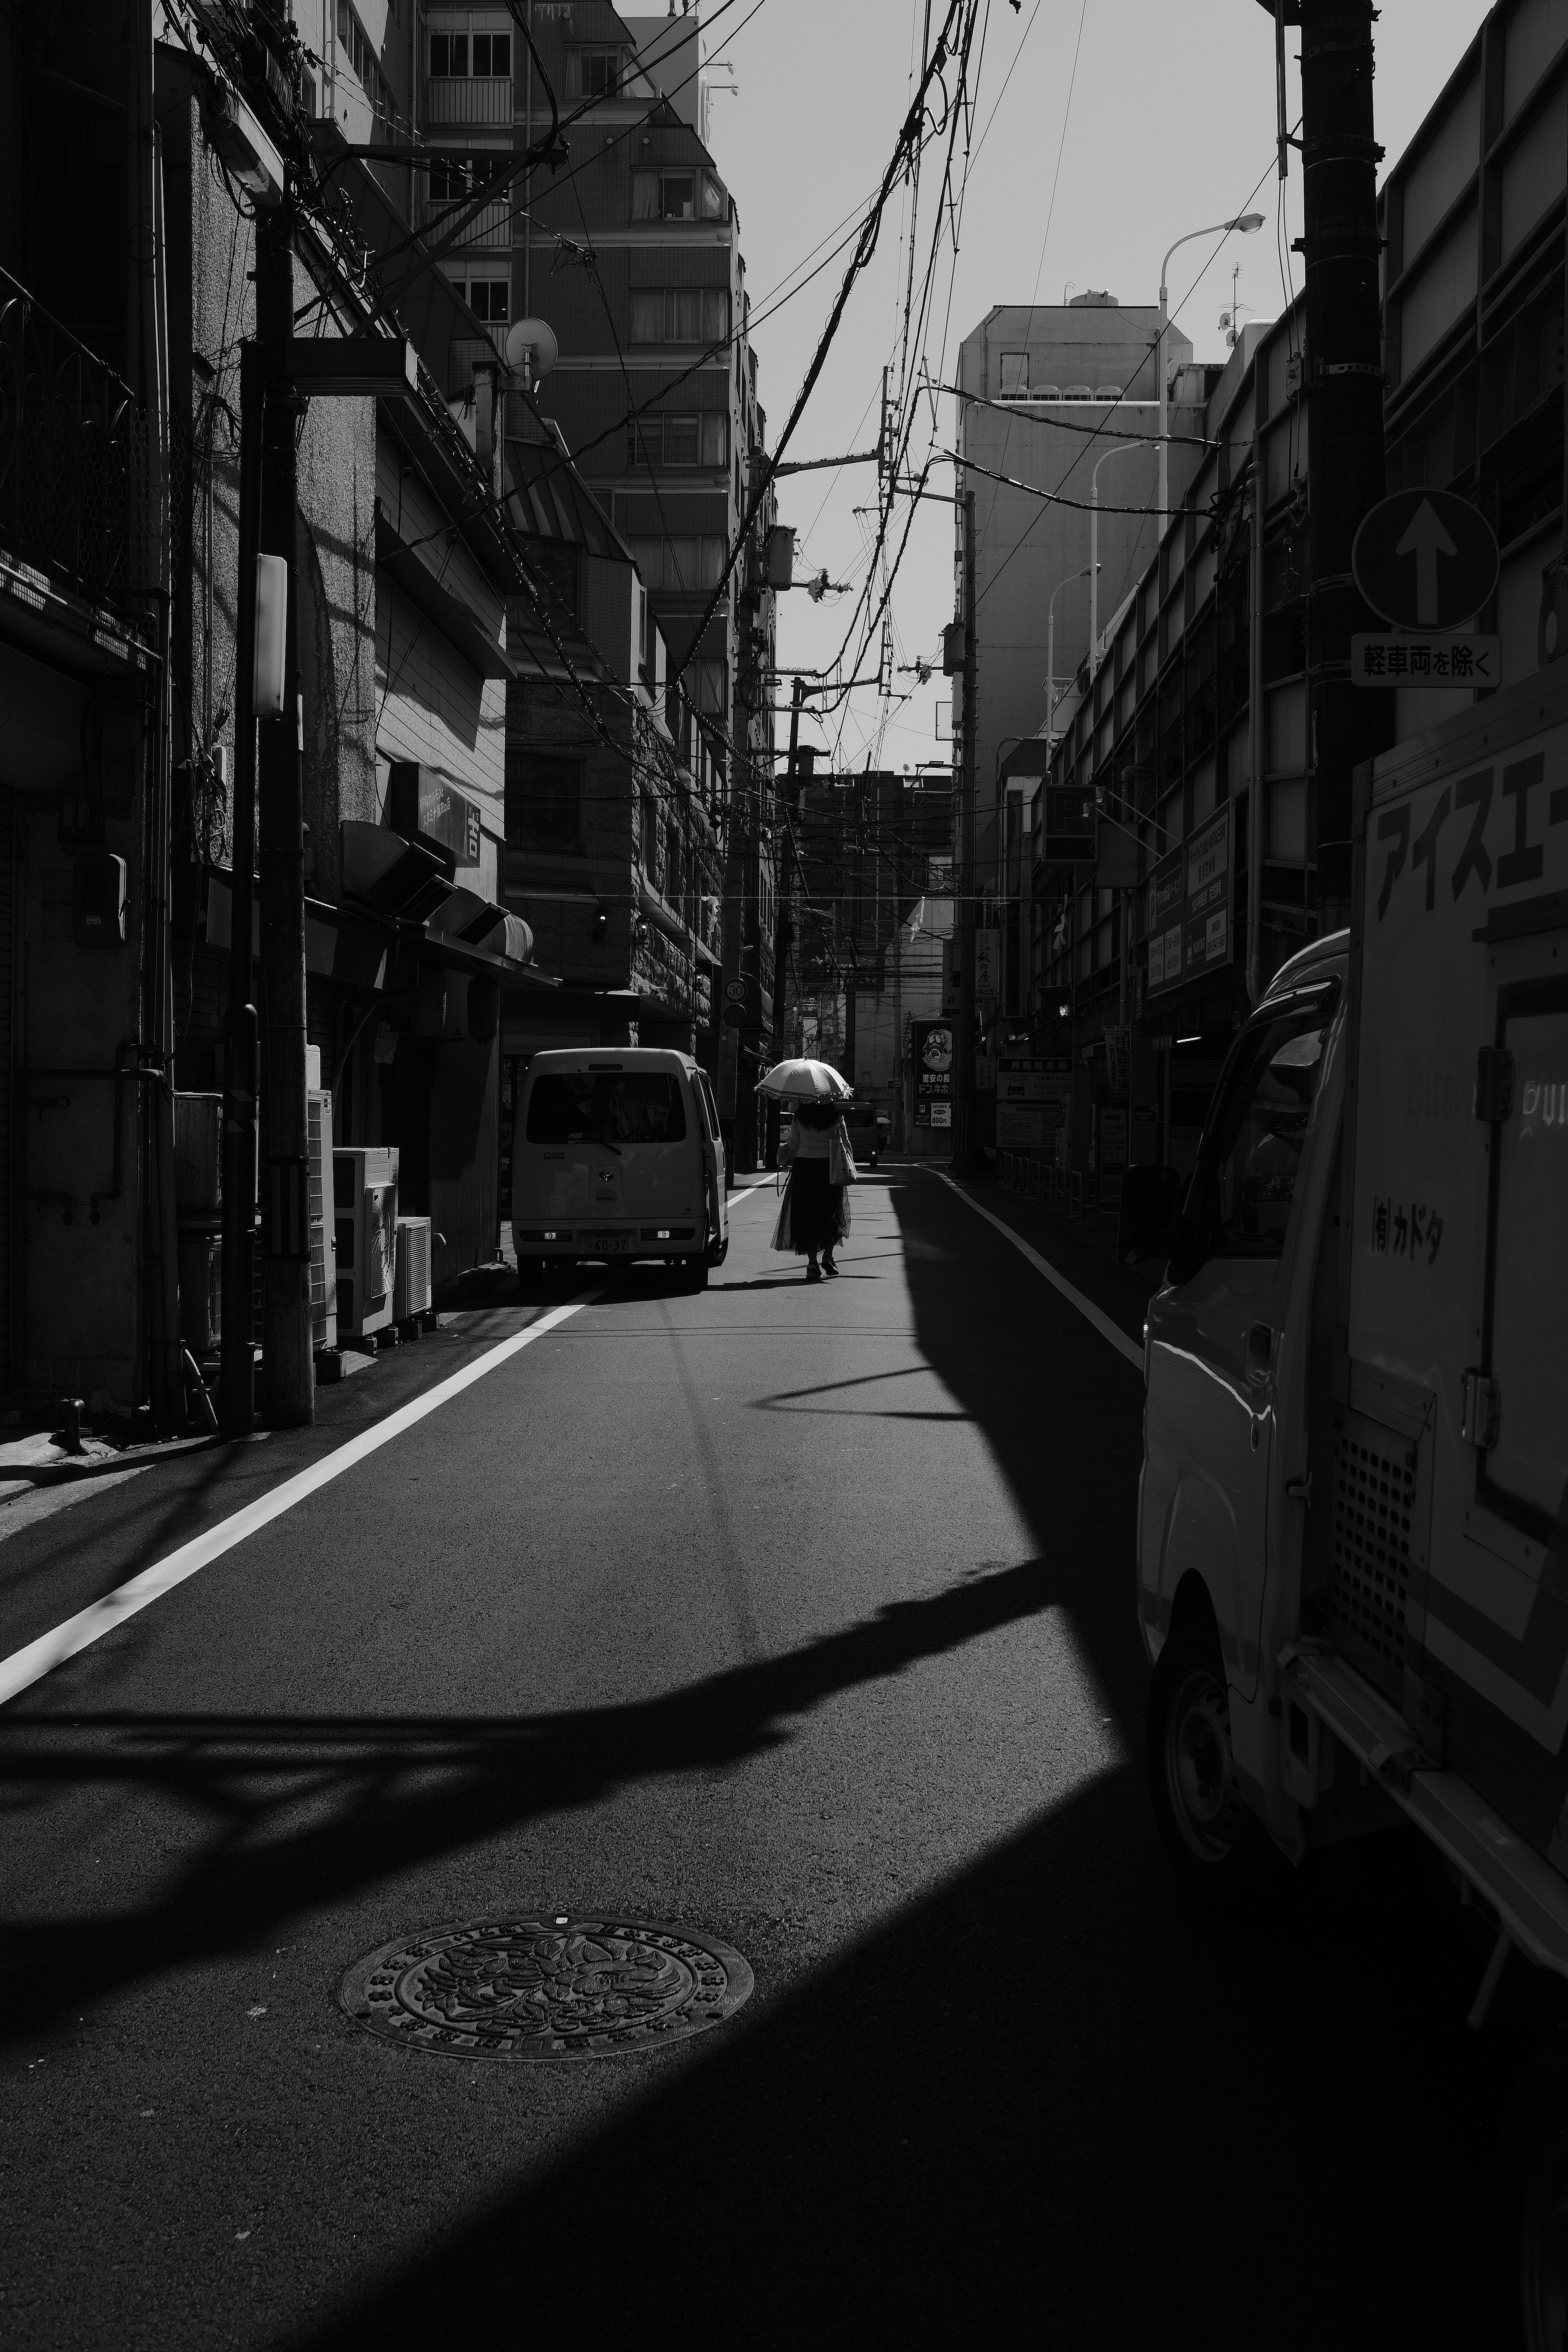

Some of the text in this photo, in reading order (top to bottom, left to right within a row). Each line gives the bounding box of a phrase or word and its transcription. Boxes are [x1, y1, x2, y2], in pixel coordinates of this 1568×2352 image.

[1364, 645, 1489, 677] 軽車両を除く
[1054, 791, 1088, 830] P
[729, 985, 742, 996] 30
[1011, 1061, 1067, 1070] 月極駐車場
[1116, 1036, 1128, 1089] 月極駐車場
[595, 1240, 626, 1251] 60-37
